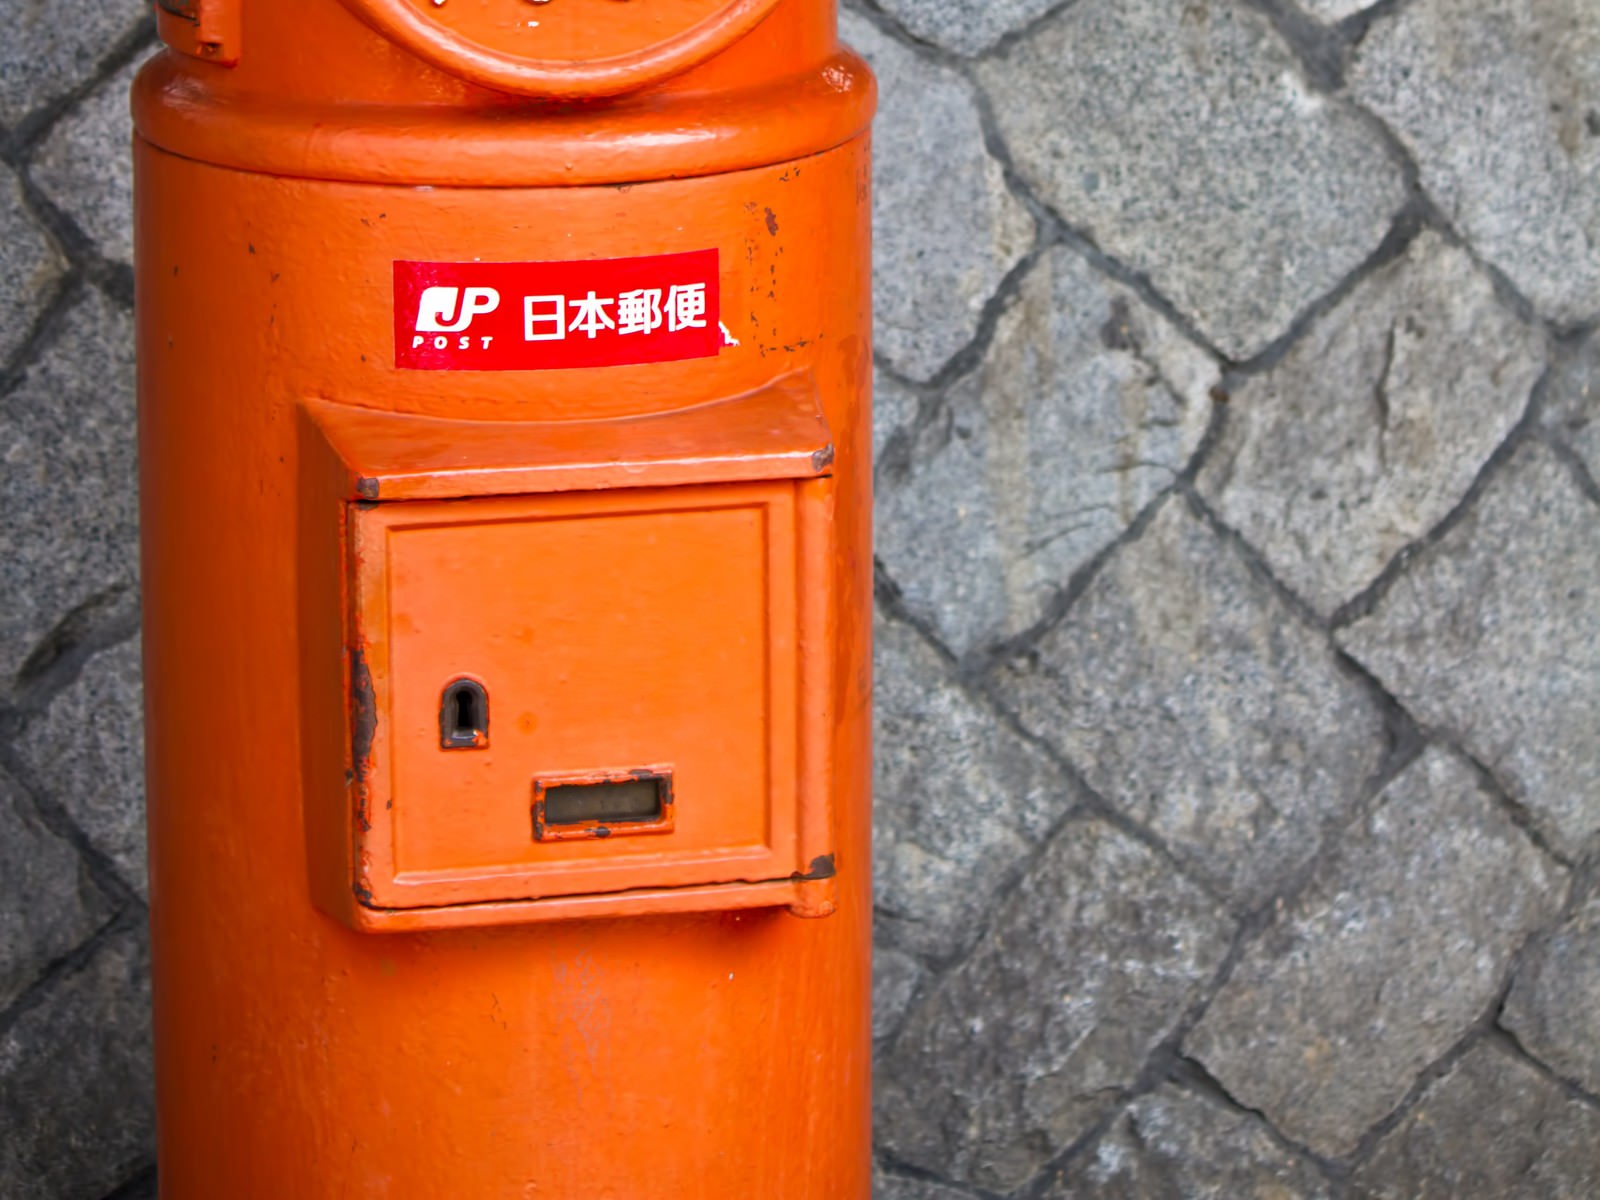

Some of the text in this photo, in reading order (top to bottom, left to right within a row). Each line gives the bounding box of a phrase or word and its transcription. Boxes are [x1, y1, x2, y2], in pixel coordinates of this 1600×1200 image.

[415, 286, 501, 333] JP
[522, 282, 708, 342] 日本郵便
[411, 335, 494, 351] POST
